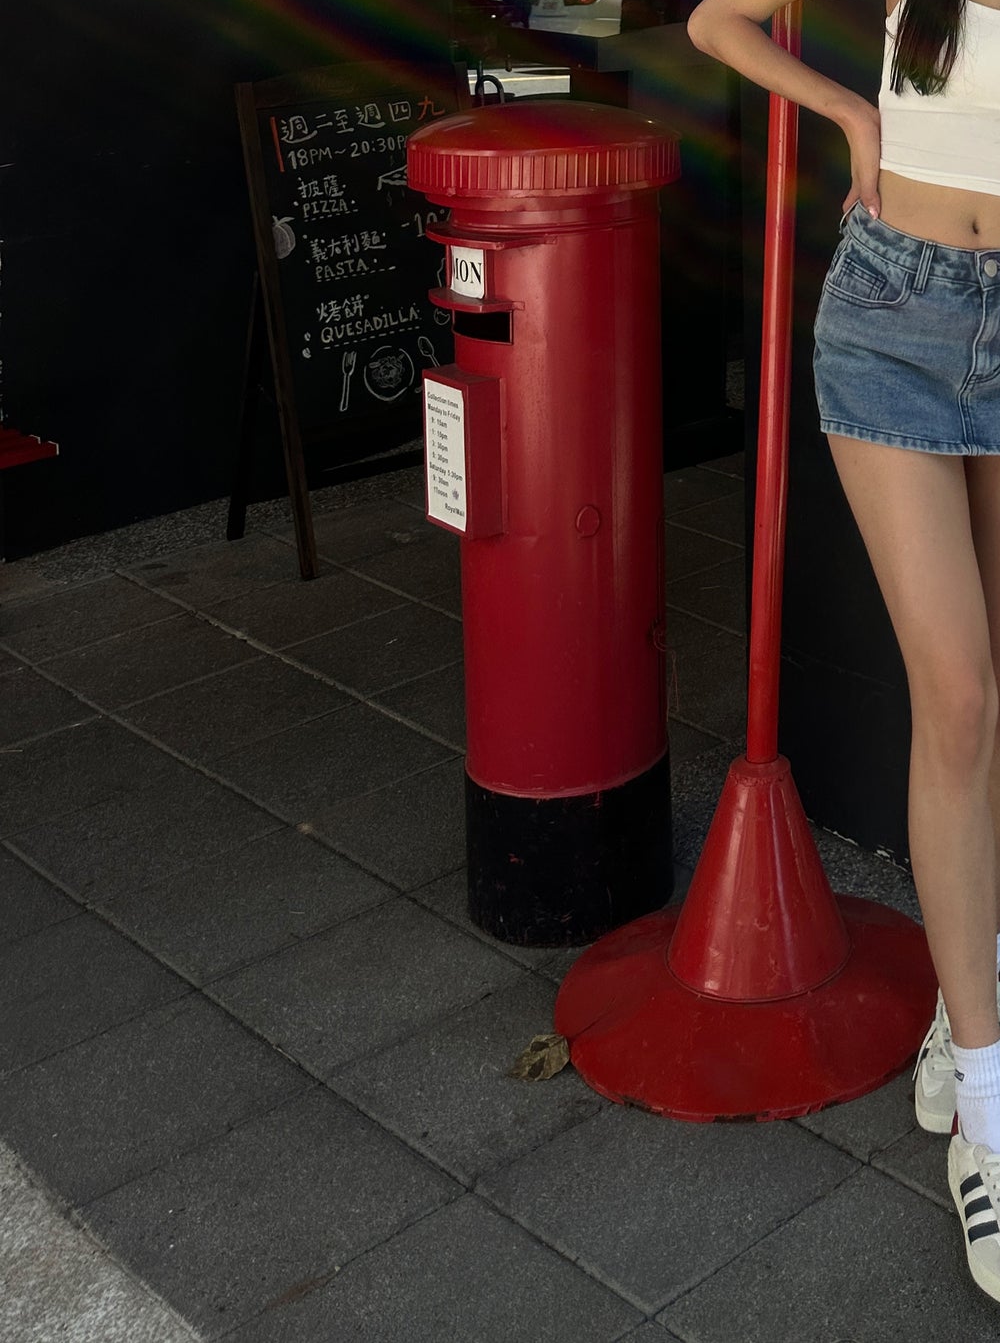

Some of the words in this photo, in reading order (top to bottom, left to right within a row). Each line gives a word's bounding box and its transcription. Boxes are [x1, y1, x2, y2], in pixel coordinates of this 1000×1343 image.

[297, 174, 345, 199] 披薩
[303, 198, 349, 219] PIZZA
[315, 258, 370, 281] PASTA
[316, 294, 365, 324] 烤餅
[320, 306, 420, 344] QUESADILLA
[427, 391, 447, 405] Collection
[447, 399, 459, 409] times
[427, 403, 442, 416] Monday
[447, 410, 461, 423] Friday
[429, 461, 447, 476] Saturday
